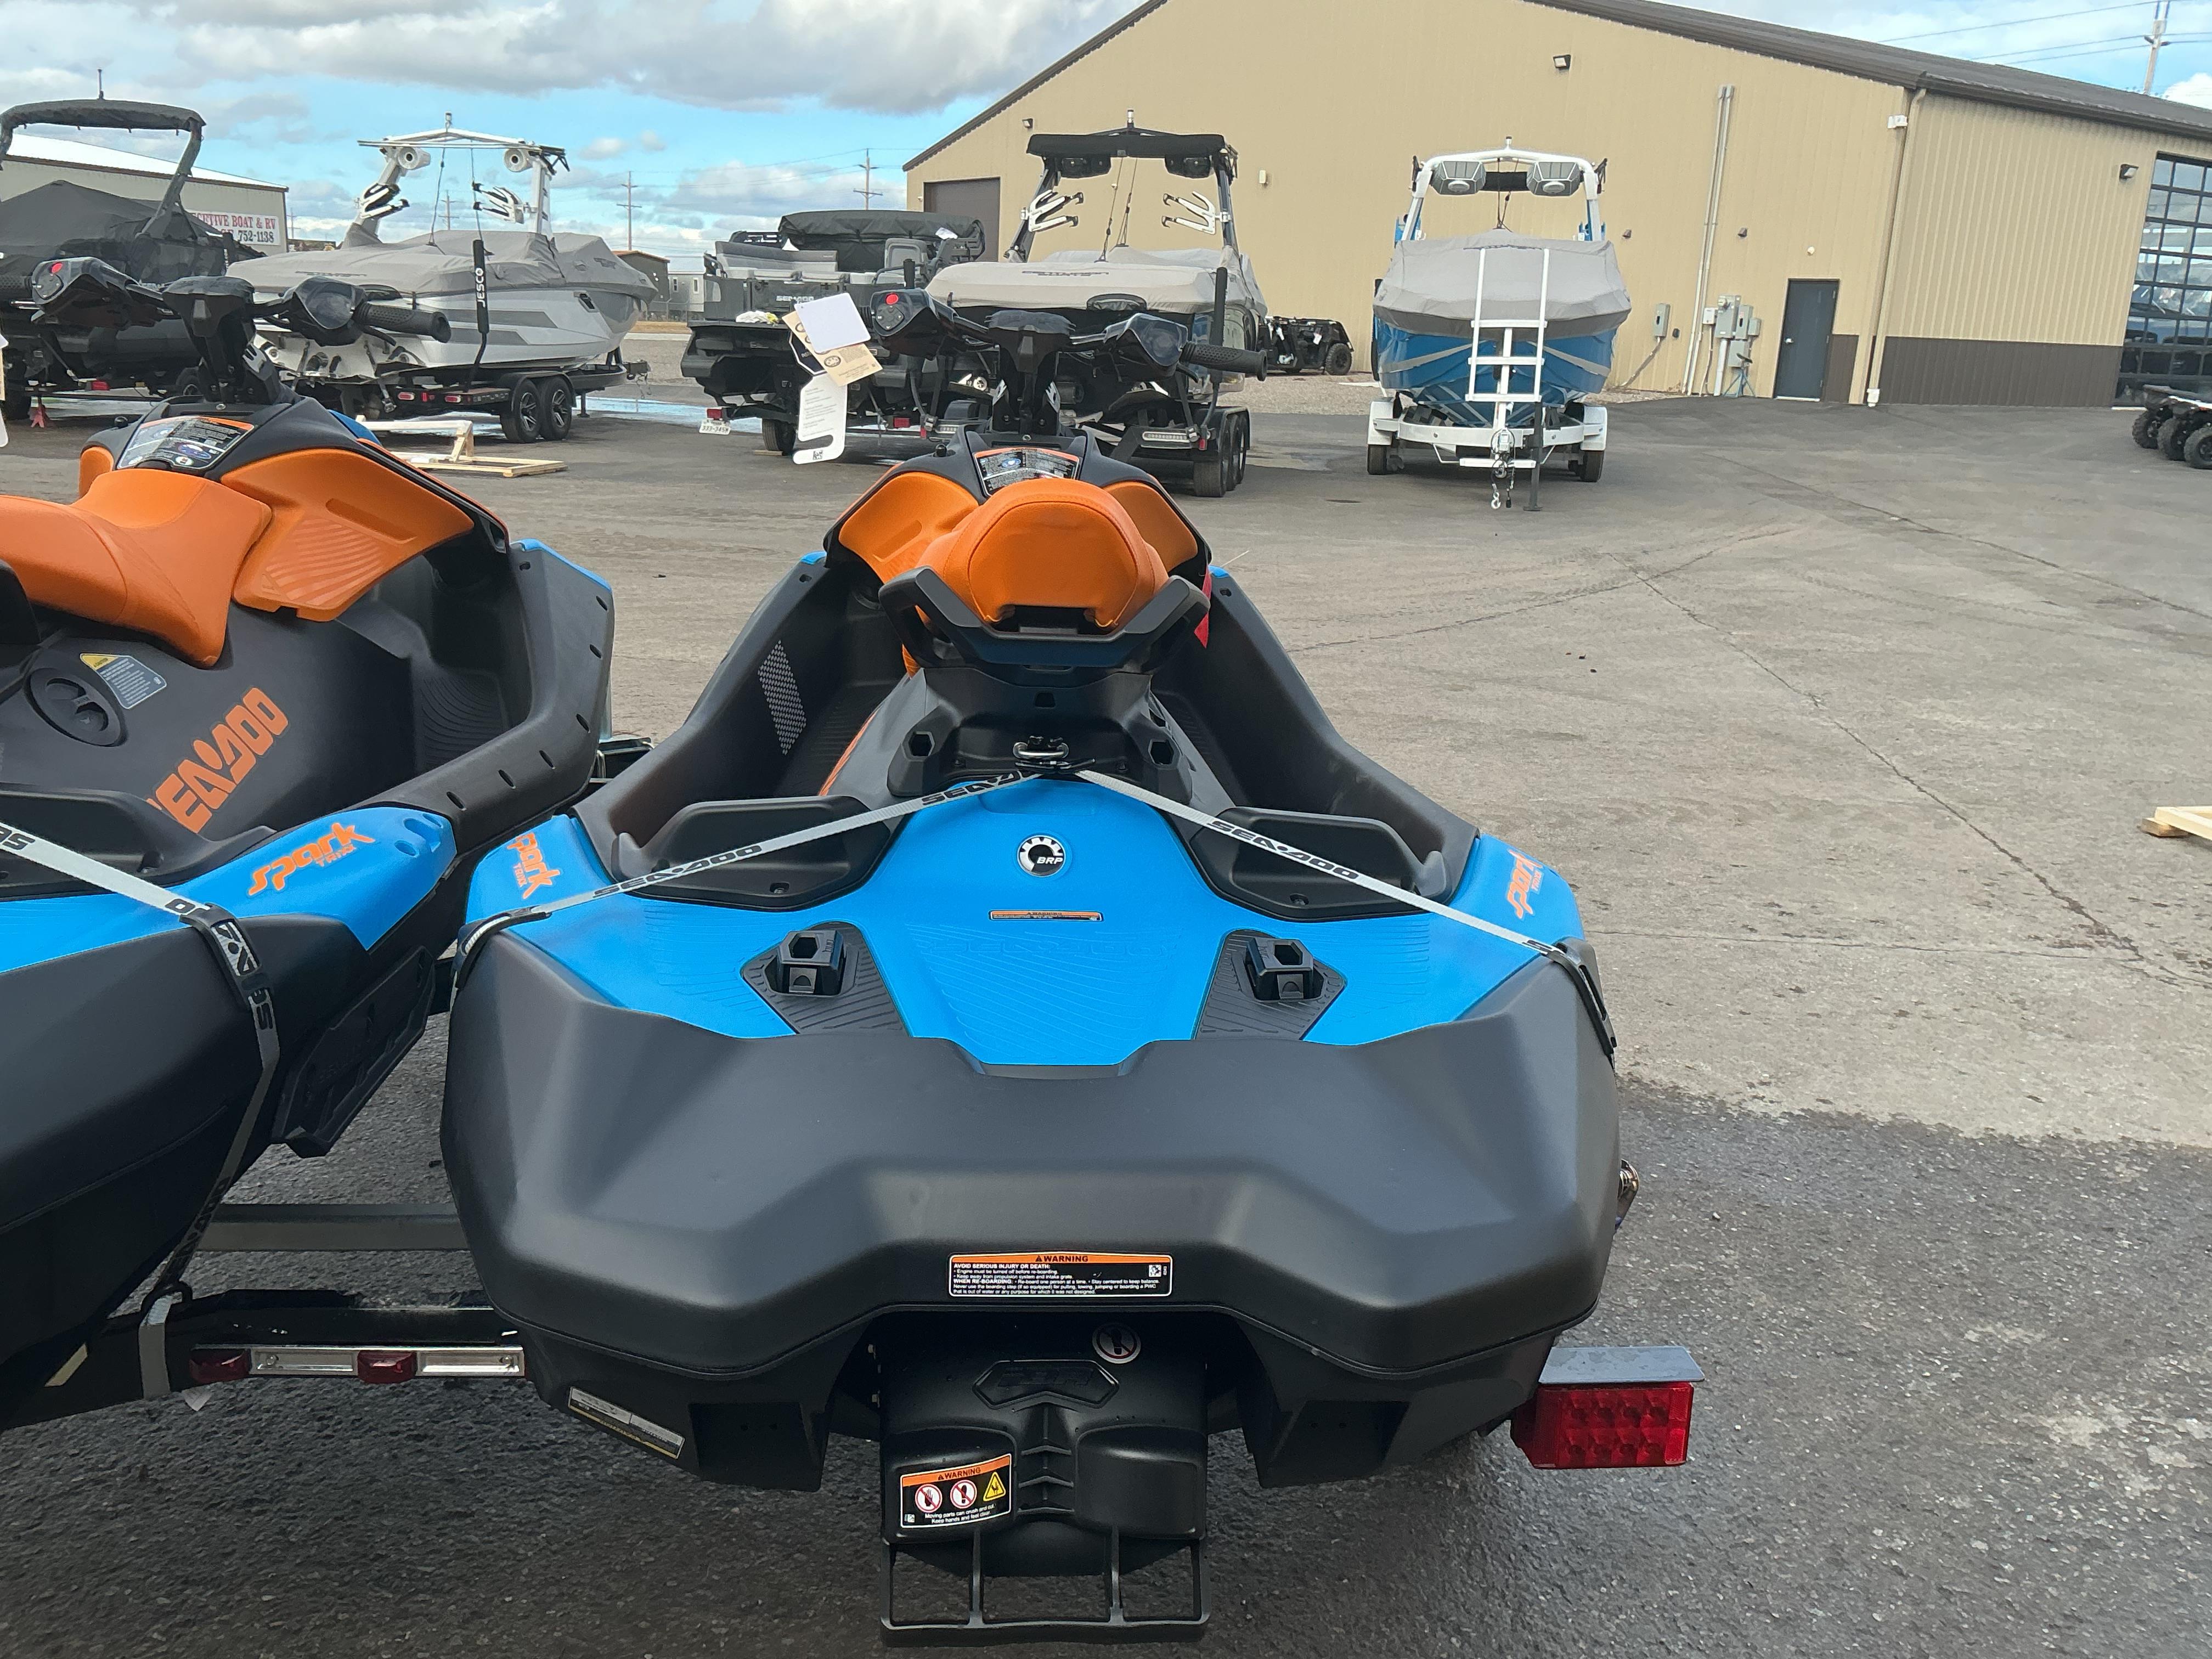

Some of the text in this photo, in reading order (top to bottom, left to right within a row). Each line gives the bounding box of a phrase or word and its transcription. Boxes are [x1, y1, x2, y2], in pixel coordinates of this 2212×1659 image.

[231, 215, 253, 228] BOAT
[256, 217, 262, 229] &
[264, 218, 276, 229] RV
[238, 229, 274, 243] 752-1138
[475, 267, 486, 308] JESCO
[1036, 856, 1063, 865] BRP
[944, 1466, 981, 1480] WARNING
